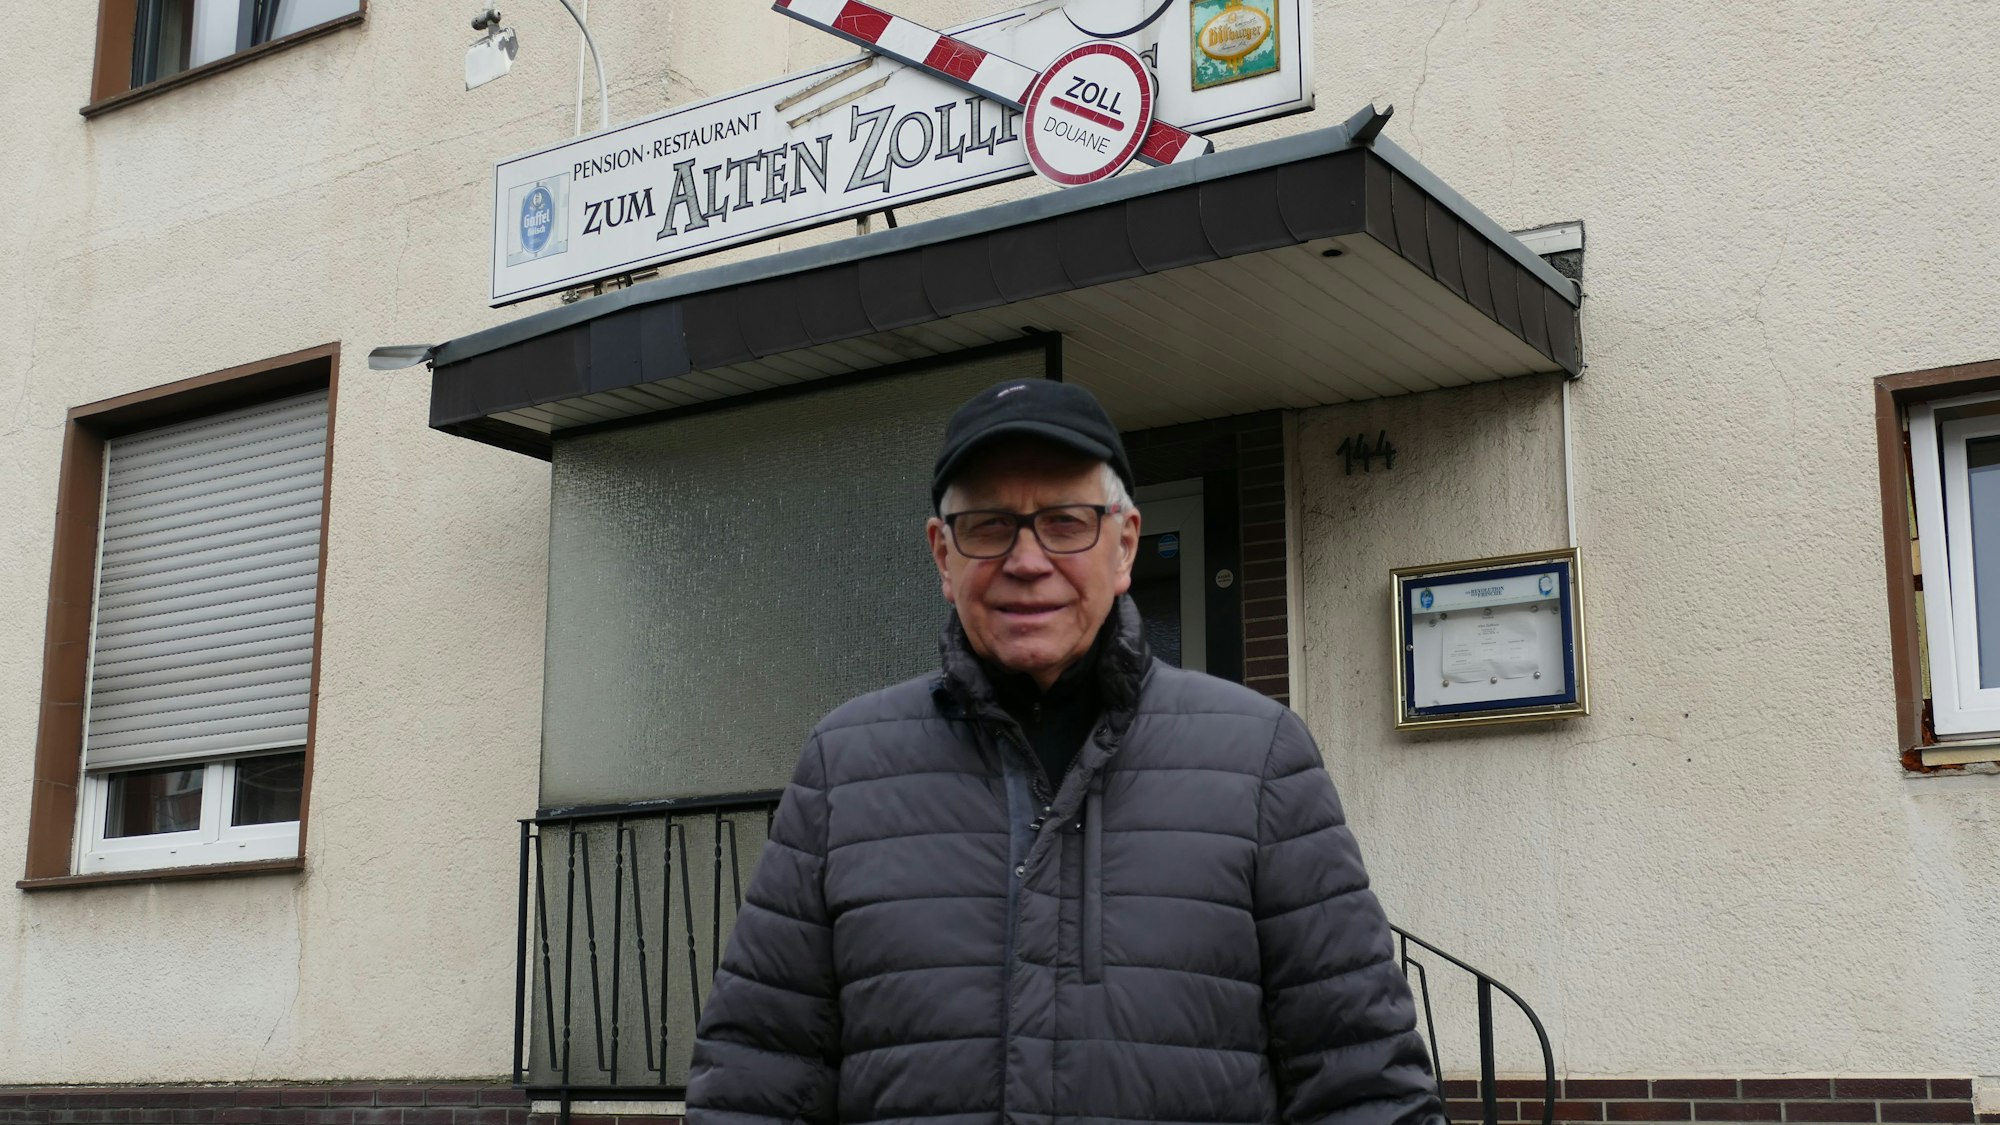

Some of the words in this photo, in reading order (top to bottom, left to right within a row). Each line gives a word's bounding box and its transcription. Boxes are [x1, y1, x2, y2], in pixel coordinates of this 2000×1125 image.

[1065, 75, 1123, 115] ZOLL
[573, 145, 644, 181] PENSION
[653, 111, 761, 159] RESTAURANT
[1043, 116, 1111, 154] DOUANE
[582, 187, 656, 236] ZUM
[656, 134, 833, 241] ALTEN
[523, 208, 551, 228] Gaffel
[1335, 430, 1397, 475] 144
